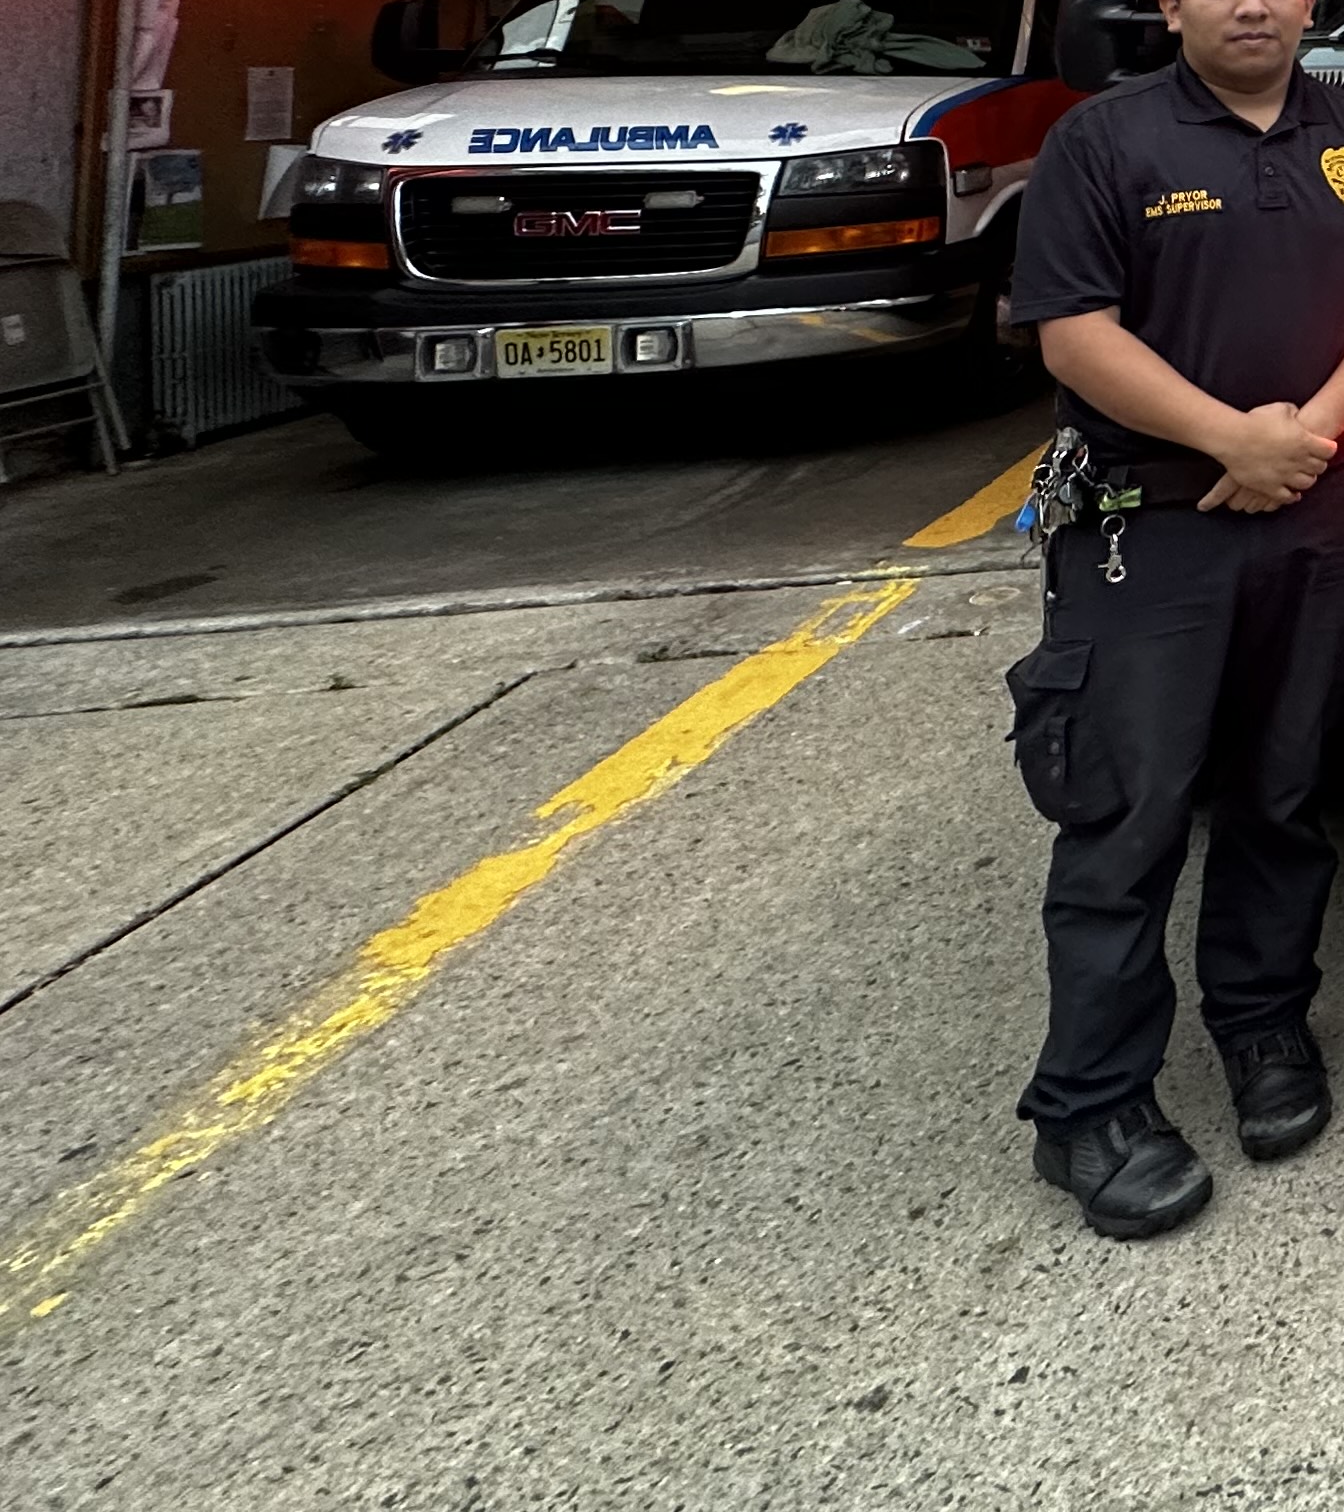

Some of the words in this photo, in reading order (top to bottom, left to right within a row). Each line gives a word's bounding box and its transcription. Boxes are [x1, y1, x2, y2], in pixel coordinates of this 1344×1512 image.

[1145, 205, 1164, 218] EMS
[1166, 198, 1223, 215] SUPERVISOR
[1170, 189, 1208, 204] PRYOR
[513, 209, 642, 237] GMC
[549, 338, 606, 364] 5801
